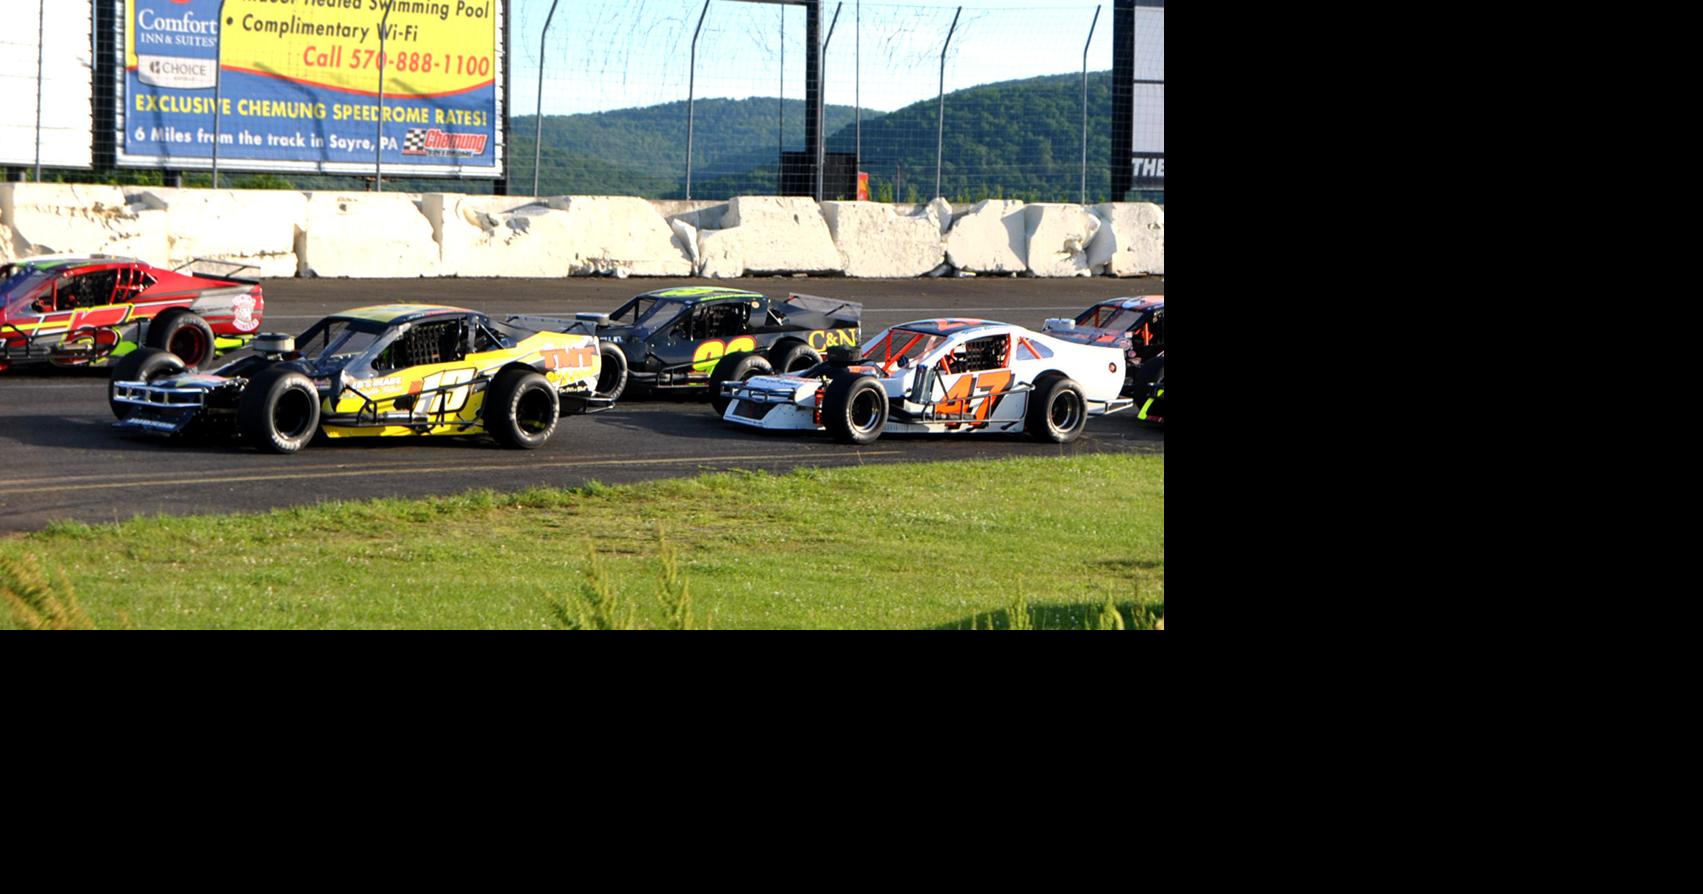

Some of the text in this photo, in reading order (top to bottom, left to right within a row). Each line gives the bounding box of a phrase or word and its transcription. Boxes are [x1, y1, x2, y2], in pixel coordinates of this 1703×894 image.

[138, 8, 217, 34] Comfort
[369, 0, 450, 20] Swimming
[456, 1, 489, 18] Pool
[175, 34, 215, 48] SUITES
[242, 13, 418, 44] Complimentary Wi-Fi
[162, 61, 207, 76] CHOICE
[303, 45, 490, 76] Call 570-888-1100
[135, 94, 487, 126] EXCLUSIVE CHEMUNG SPEEDROME RATES!
[134, 127, 398, 152] 6 Miles from the track in Sayre, PA
[425, 129, 487, 154] Chemung
[1132, 157, 1164, 177] THE
[808, 328, 858, 353] C&N
[934, 369, 1013, 427] 47
